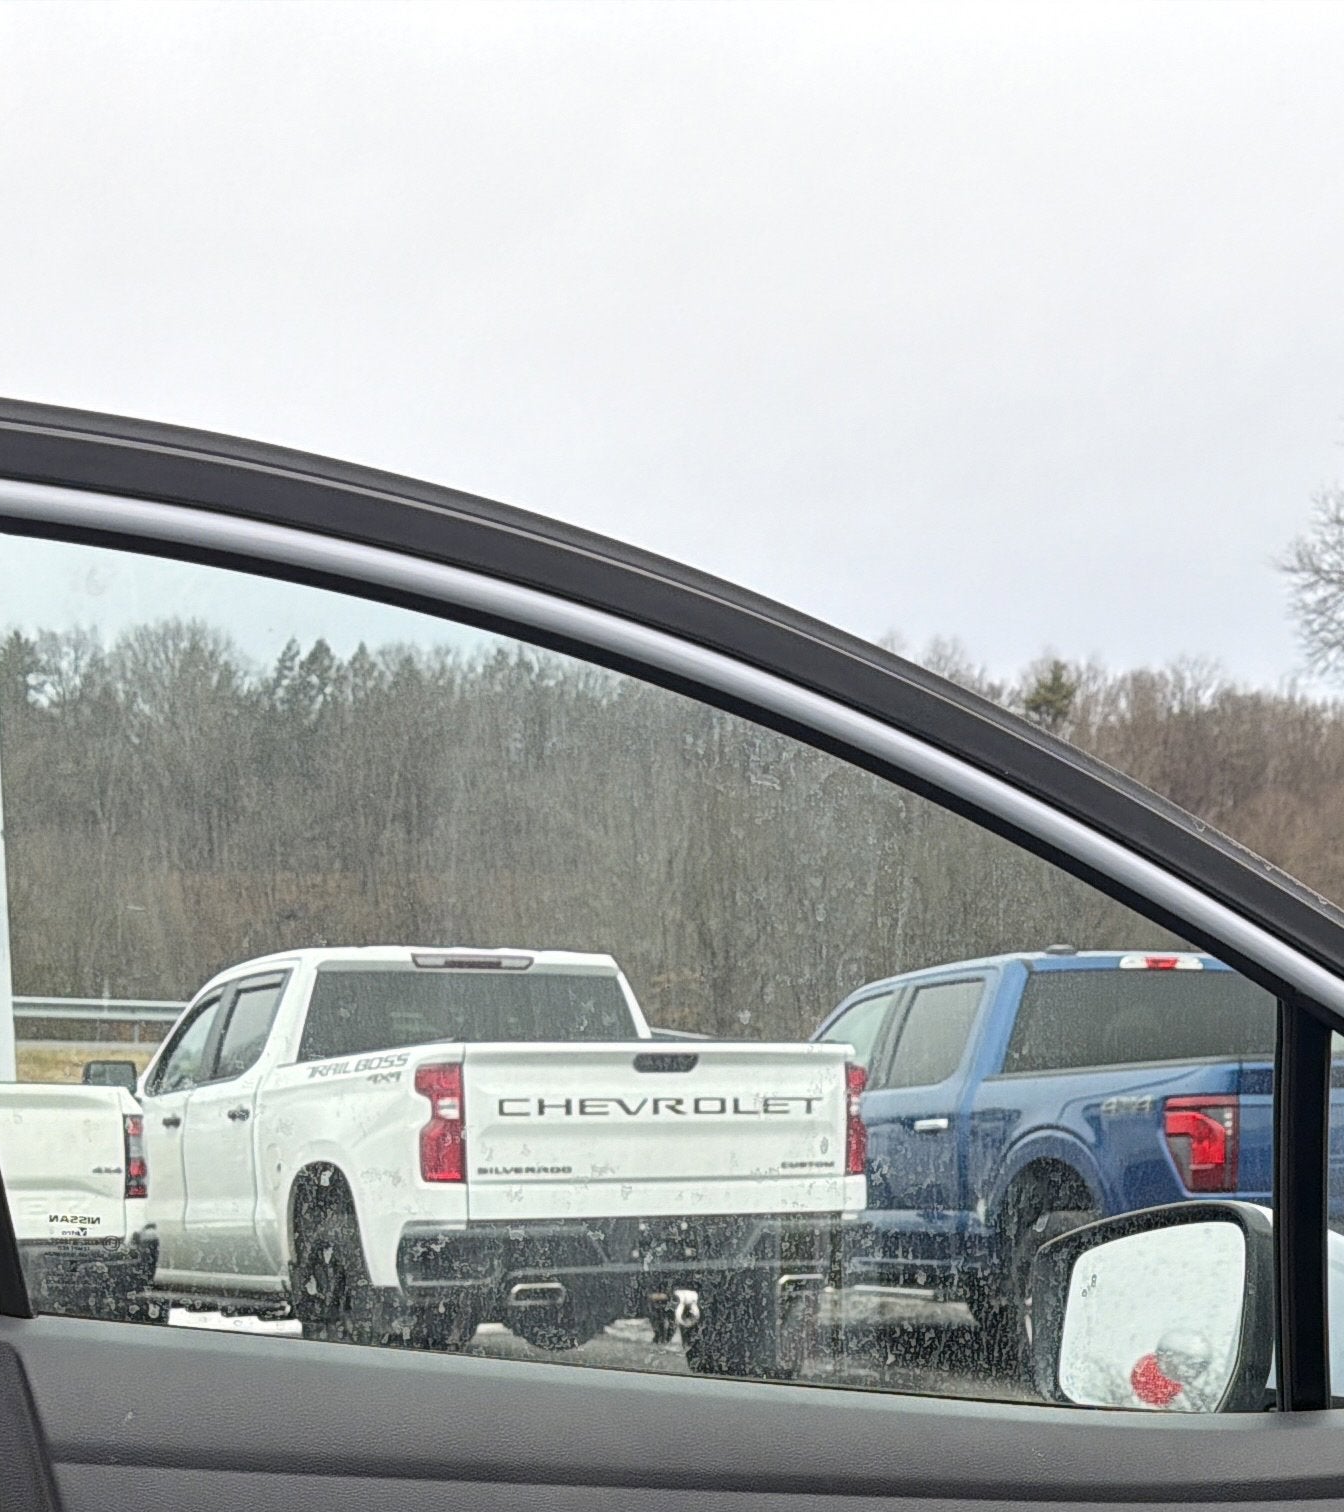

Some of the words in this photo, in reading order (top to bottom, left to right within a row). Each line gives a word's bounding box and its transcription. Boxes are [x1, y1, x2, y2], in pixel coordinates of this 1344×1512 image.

[307, 1061, 351, 1079] TRAIL
[354, 1053, 411, 1073] BOSS
[498, 1097, 824, 1117] CHEVROLET
[477, 1166, 573, 1175] SILVERADO
[781, 1160, 835, 1169] CUSTOM
